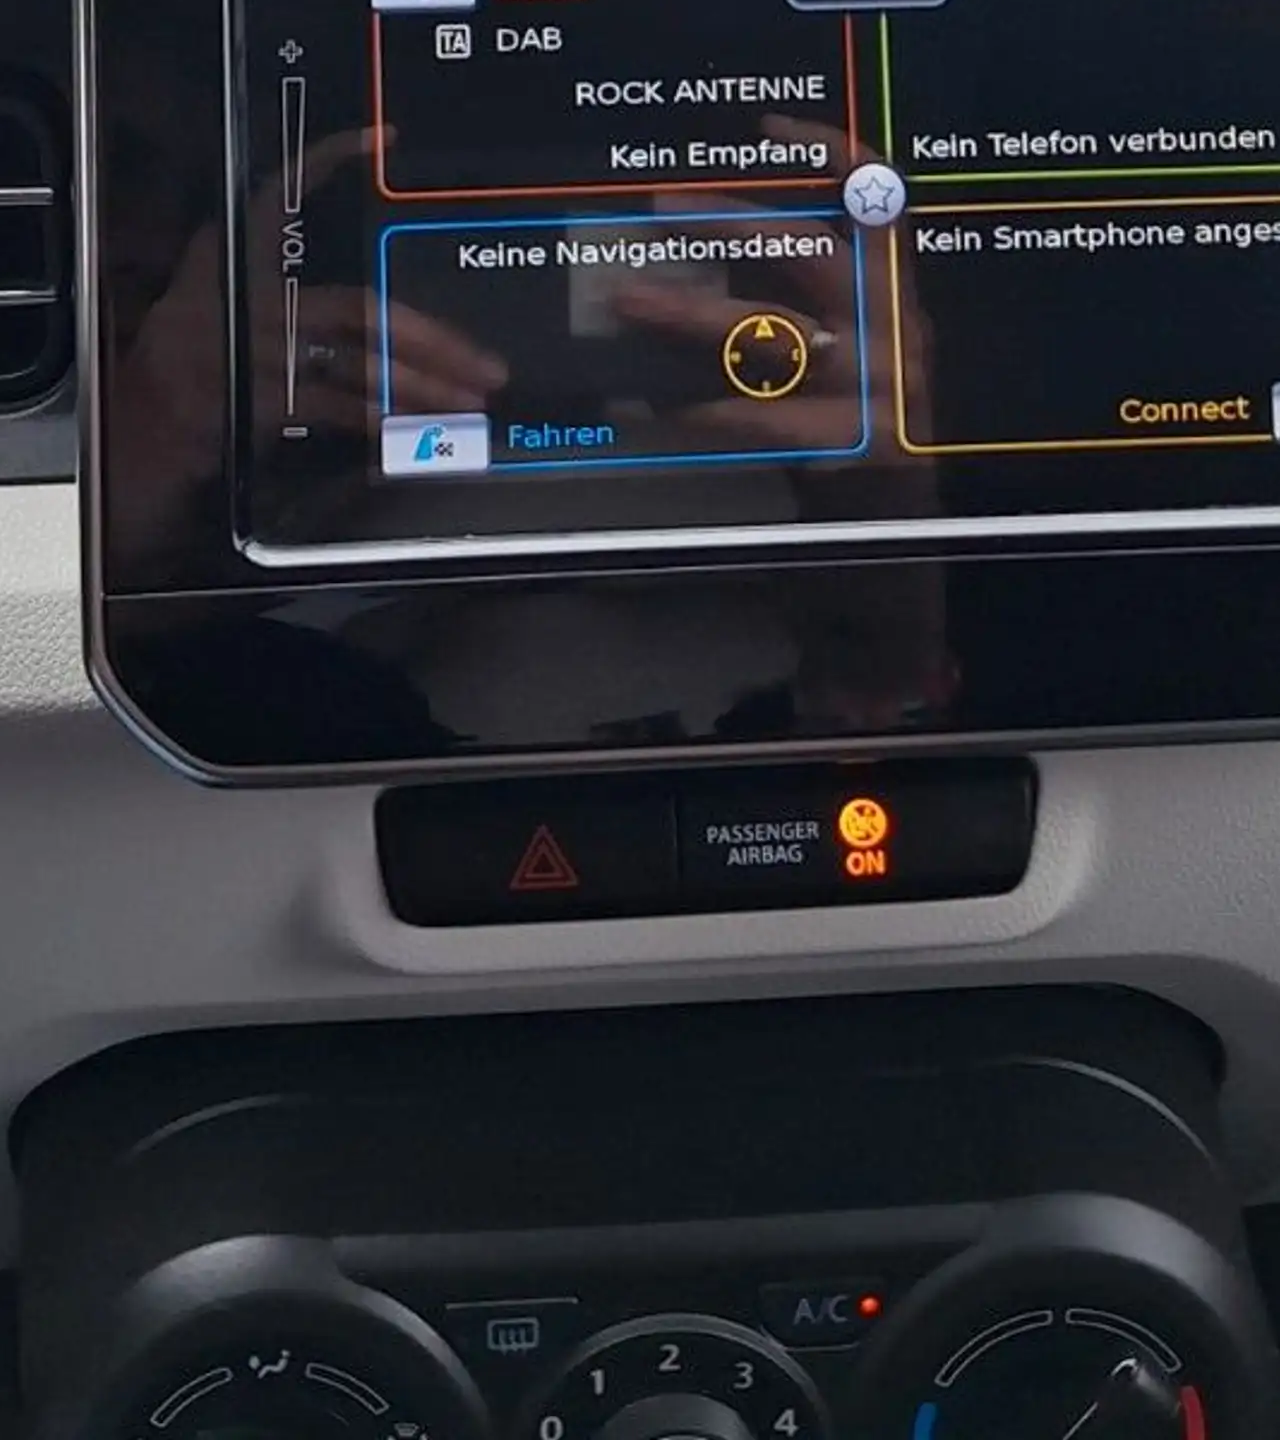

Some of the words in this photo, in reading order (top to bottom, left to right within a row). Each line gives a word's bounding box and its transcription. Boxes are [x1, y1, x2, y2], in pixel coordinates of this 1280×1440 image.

[441, 31, 466, 53] TA
[497, 27, 562, 51] DAB
[576, 81, 664, 105] ROCK
[674, 76, 825, 102] ANTENNE
[612, 144, 675, 168] Kein
[689, 140, 827, 169] Empfang
[914, 134, 977, 158] Kein
[988, 130, 1097, 156] Telefon
[1109, 126, 1275, 152] verbunden
[283, 221, 304, 272] VOL
[917, 228, 981, 251] Kein
[994, 222, 1185, 251] Smartphone
[460, 243, 545, 267] Keine
[557, 233, 833, 267] Navigationsdaten
[1120, 397, 1249, 423] Connect
[509, 423, 613, 448] Fahren
[706, 821, 819, 844] PASSENGER
[726, 845, 803, 865] AIRBAG
[846, 849, 885, 875] ON
[794, 1296, 848, 1324] A/C
[659, 1344, 680, 1370] 2
[591, 1370, 603, 1394] 1
[735, 1362, 753, 1388] 3
[541, 1416, 562, 1440] 0
[774, 1409, 798, 1436] 4
